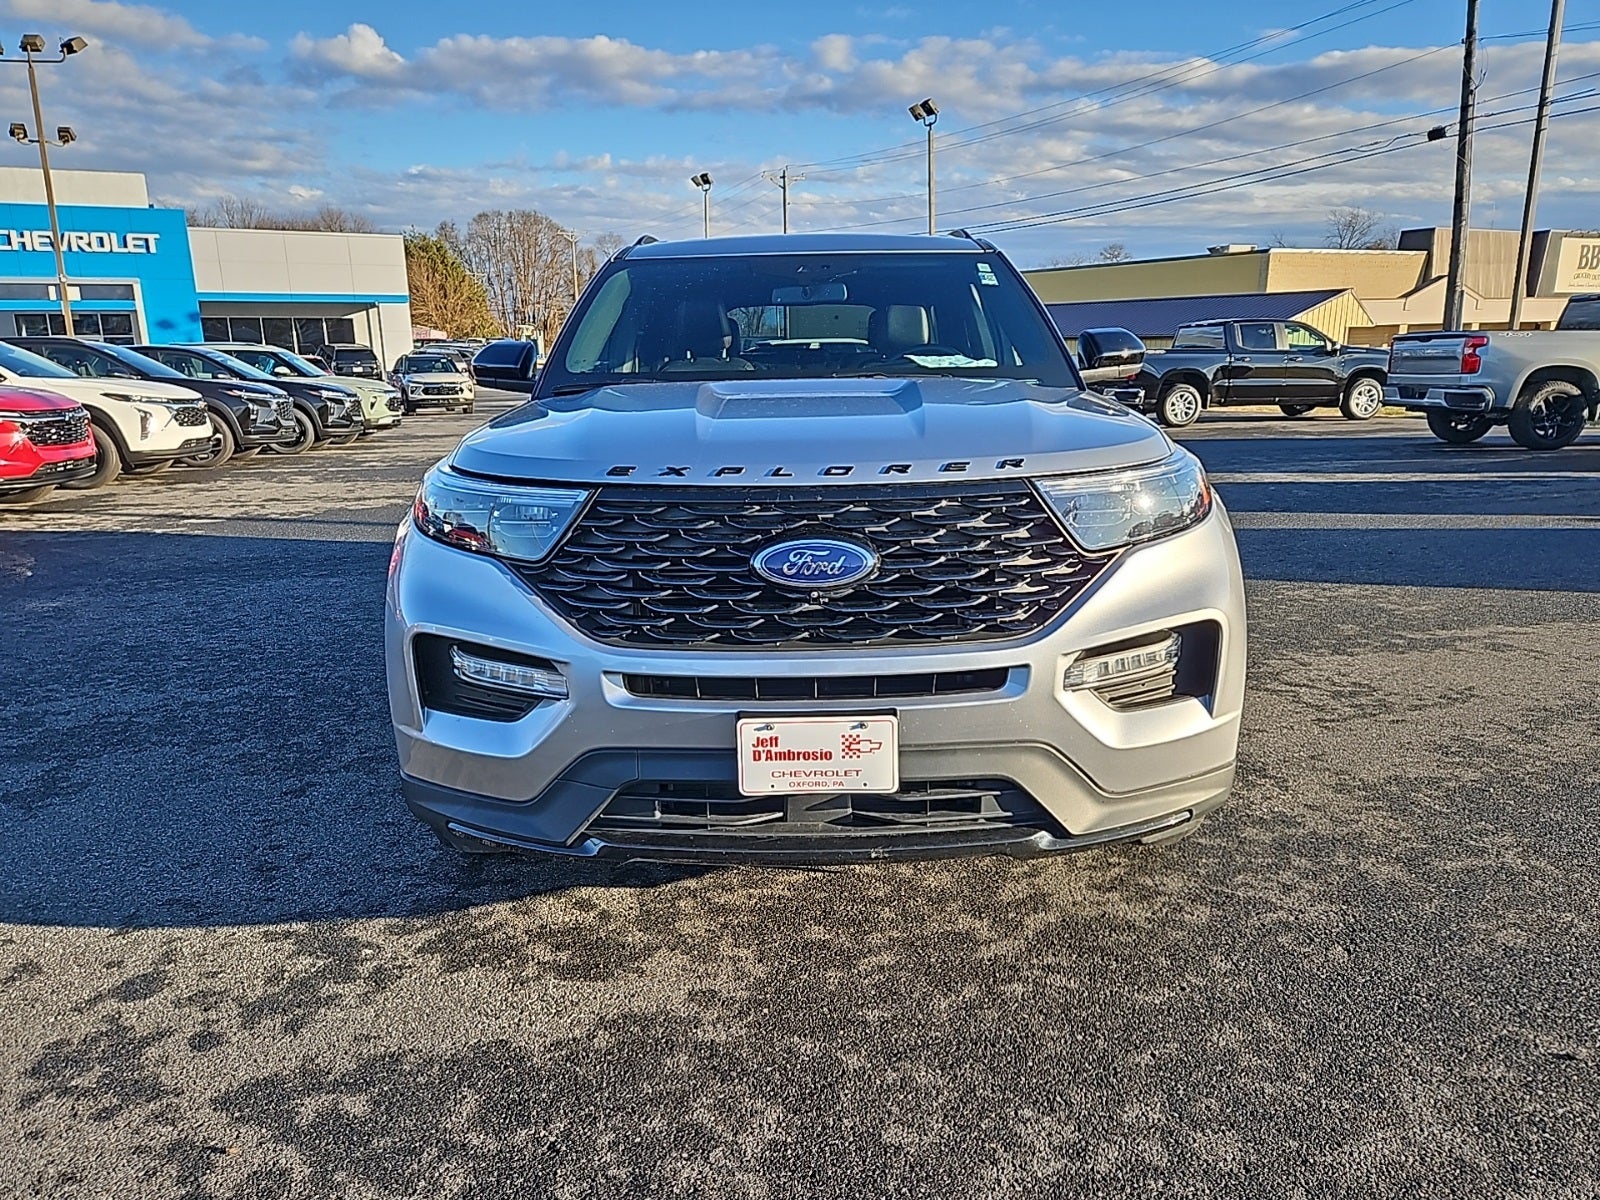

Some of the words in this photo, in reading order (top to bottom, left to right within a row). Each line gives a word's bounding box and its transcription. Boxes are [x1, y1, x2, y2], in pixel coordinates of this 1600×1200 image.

[604, 458, 1025, 478] EXPLORER
[783, 549, 847, 575] Ford
[752, 736, 779, 748] Jeff
[752, 749, 833, 762] D'Ambrosio
[771, 769, 863, 778] CHEVROLET
[788, 780, 830, 788] OXFORD,
[832, 780, 845, 788] PA
